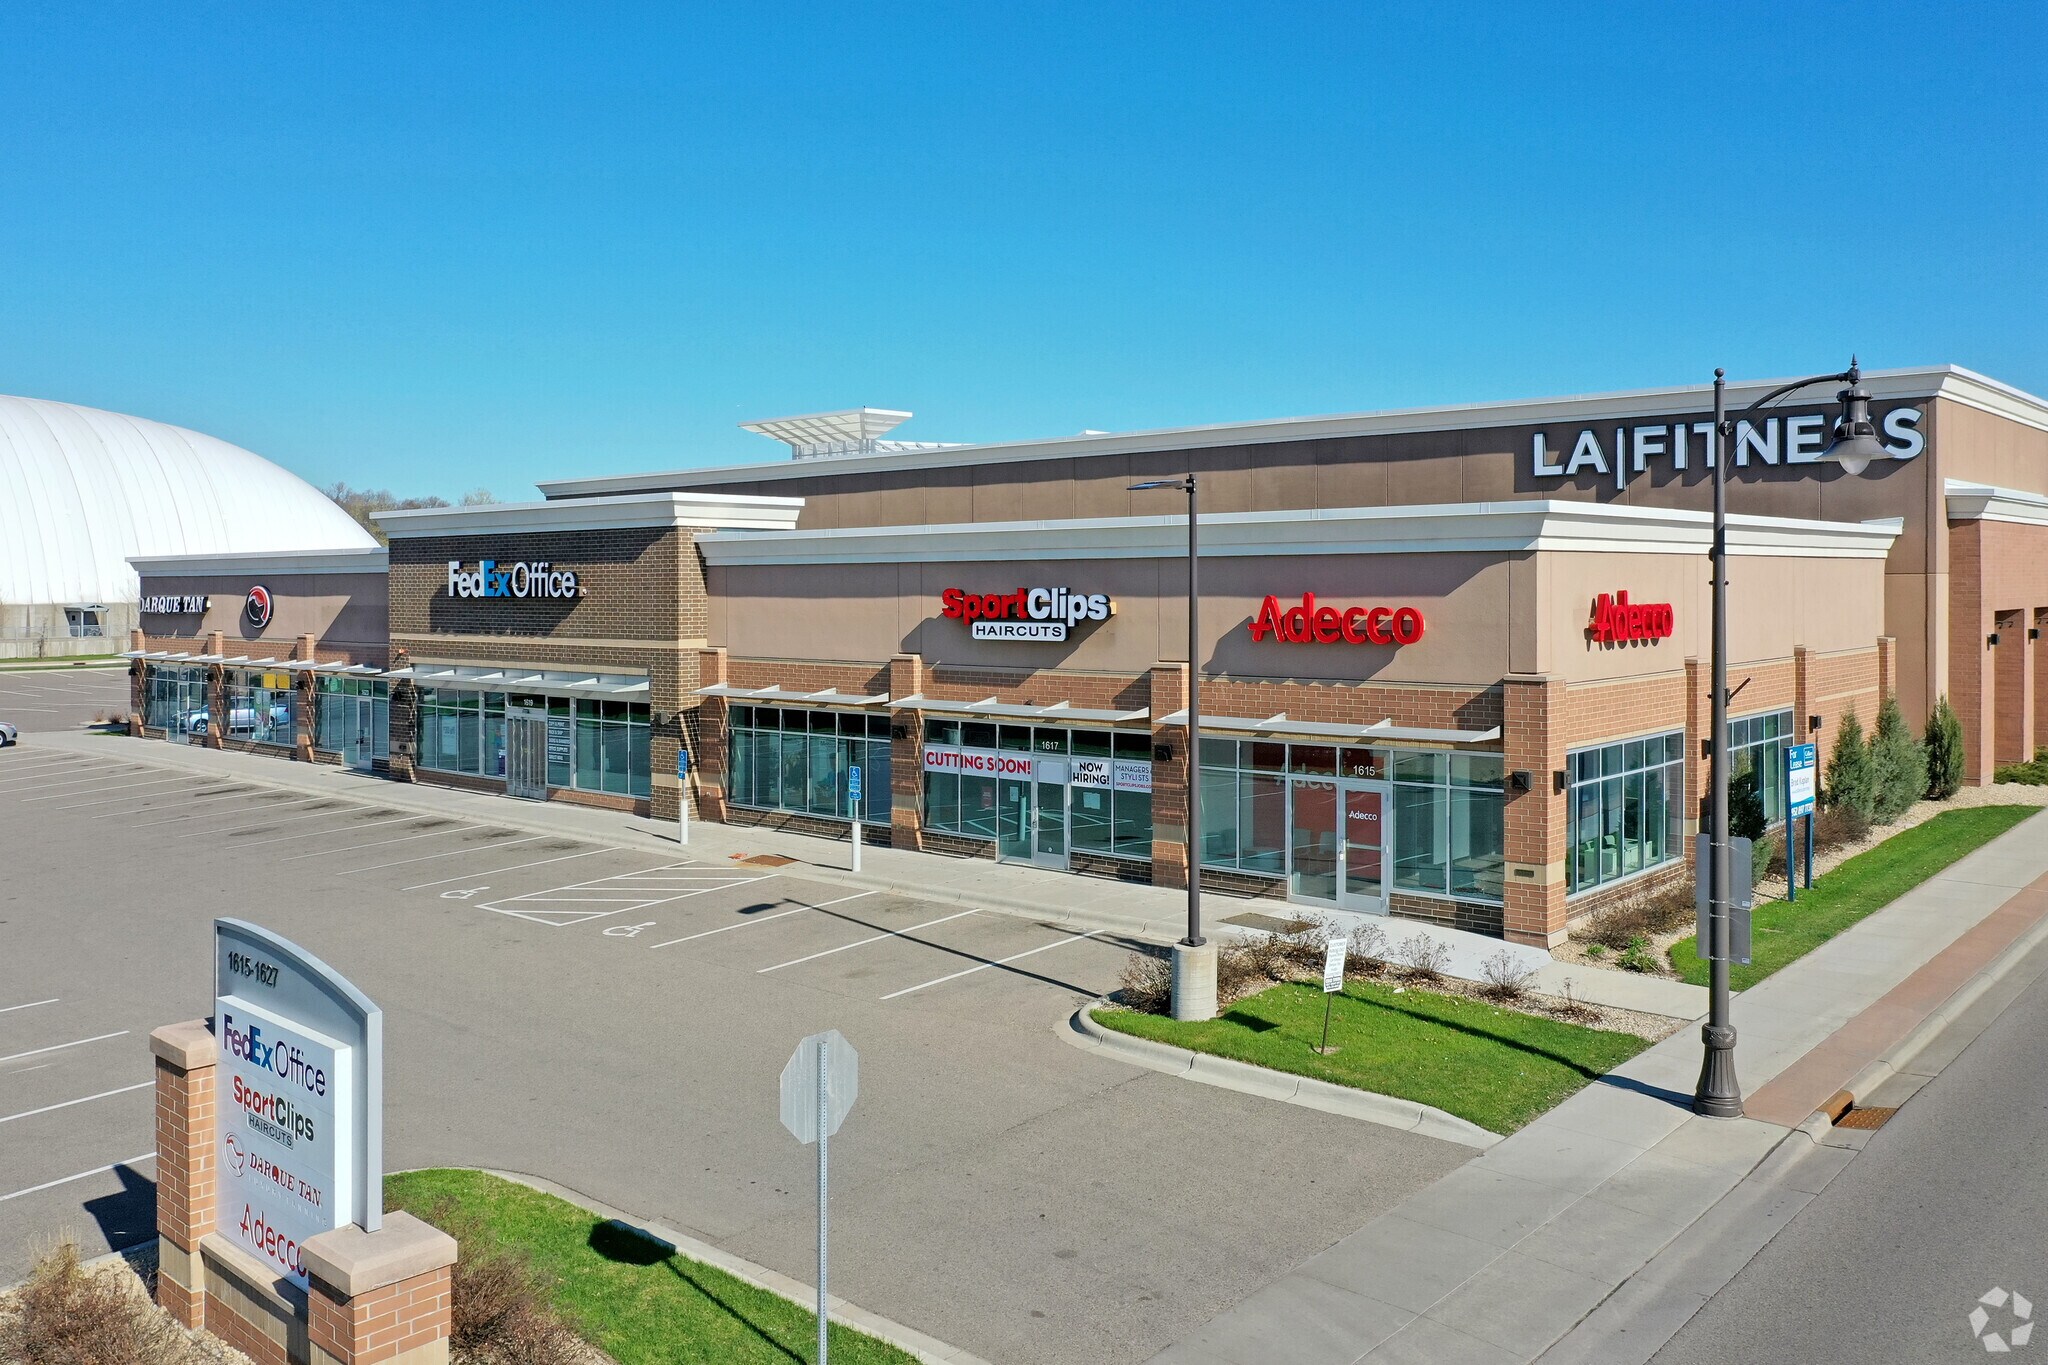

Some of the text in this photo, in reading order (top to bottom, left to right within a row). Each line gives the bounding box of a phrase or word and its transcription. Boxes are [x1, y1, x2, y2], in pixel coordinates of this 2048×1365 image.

[1532, 407, 1927, 477] LA FITNES
[448, 560, 576, 598] FedEx Office
[139, 596, 205, 613] DARQUE TAN
[1247, 591, 1426, 645] Adecco
[1588, 589, 1674, 643] Adecco
[975, 625, 1062, 637] HAIRCUTS
[1041, 740, 1059, 750] 1617
[926, 751, 1031, 775] CUTTING SOON!
[1079, 762, 1103, 773] NOW
[1115, 765, 1150, 774] MANAGERS
[1353, 764, 1376, 776] 1615
[1072, 772, 1110, 785] HIRING!
[1120, 773, 1149, 782] STYLISTS
[1348, 810, 1378, 821] Adecco
[228, 951, 279, 989] 1615-1627
[223, 1013, 326, 1097] FedEx Office
[249, 1113, 293, 1148] HAIRCUTS
[249, 1152, 322, 1207] DARQUE TAN
